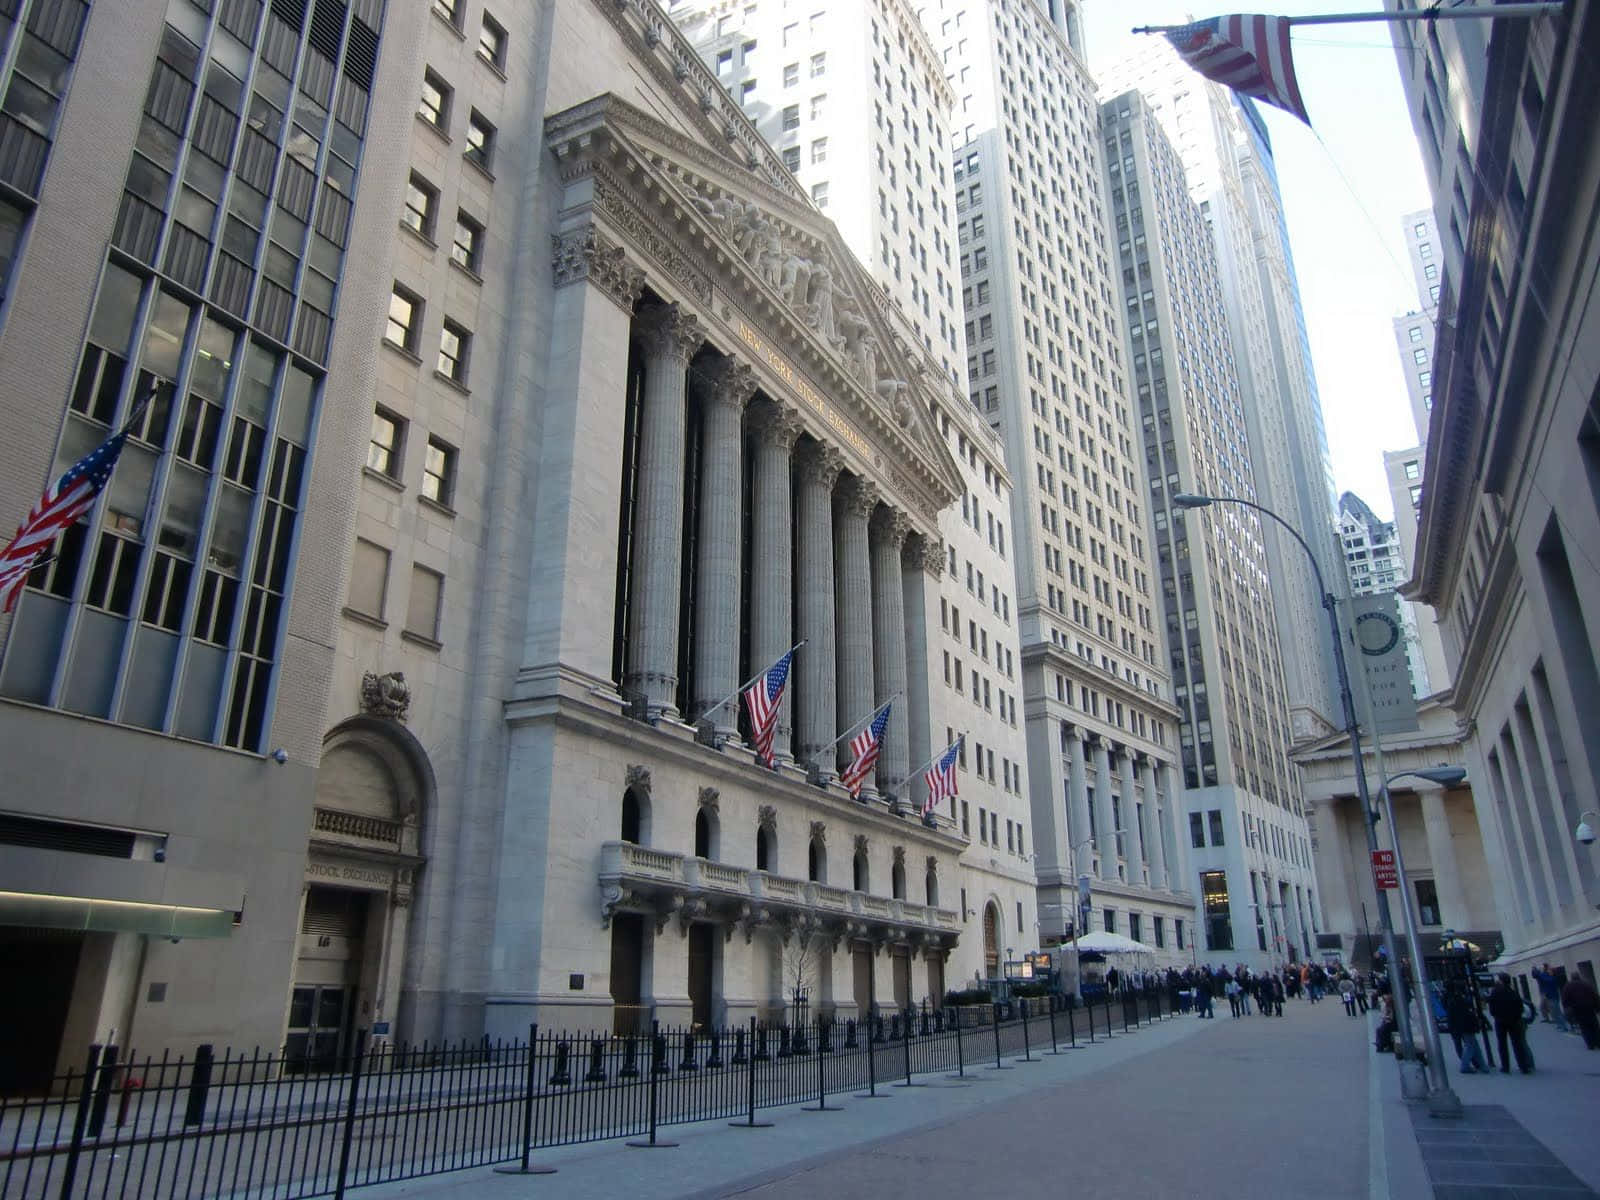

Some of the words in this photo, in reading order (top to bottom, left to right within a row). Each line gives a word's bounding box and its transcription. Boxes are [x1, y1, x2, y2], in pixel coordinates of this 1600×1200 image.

[740, 320, 761, 352] NEW
[767, 347, 793, 384] YORK
[798, 379, 824, 415] STOCK
[828, 409, 870, 459] EXCHANGE
[1381, 854, 1392, 863] NO
[310, 864, 339, 878] STOCK
[343, 868, 390, 884] EXCHANGE
